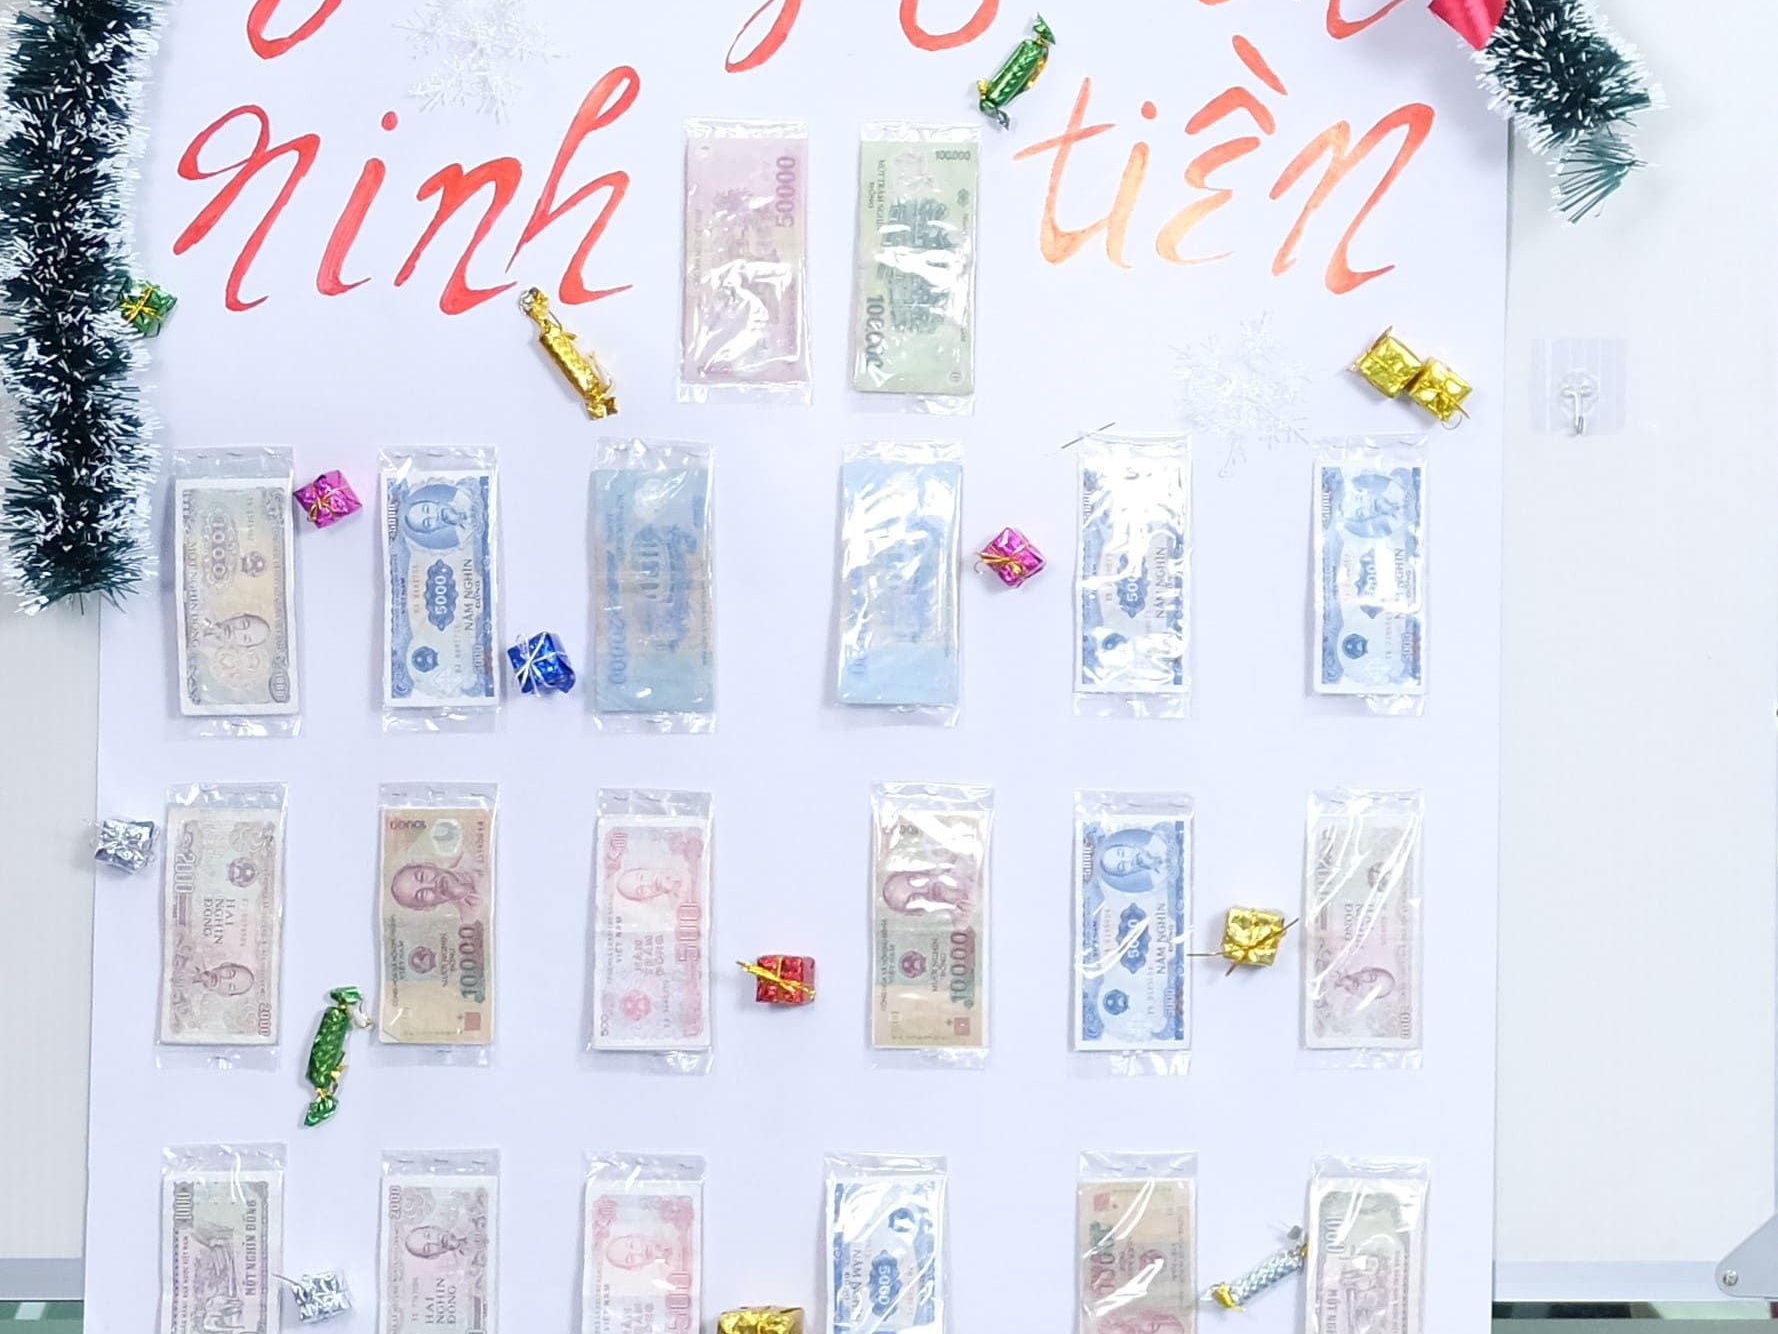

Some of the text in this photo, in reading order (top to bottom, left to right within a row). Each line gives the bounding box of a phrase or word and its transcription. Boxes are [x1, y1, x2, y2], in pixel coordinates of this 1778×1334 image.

[775, 156, 797, 228] 50000
[212, 522, 225, 575] 1000
[435, 575, 448, 615] 5000
[174, 852, 197, 894] 2000
[224, 898, 236, 927] HAI
[675, 902, 701, 962] 500
[458, 926, 478, 998] 10000
[950, 931, 968, 1002] 10000
[600, 1014, 609, 1037] 500
[175, 1192, 192, 1220] 1000
[879, 1266, 890, 1305] 5000
[425, 1297, 435, 1324] HAI
